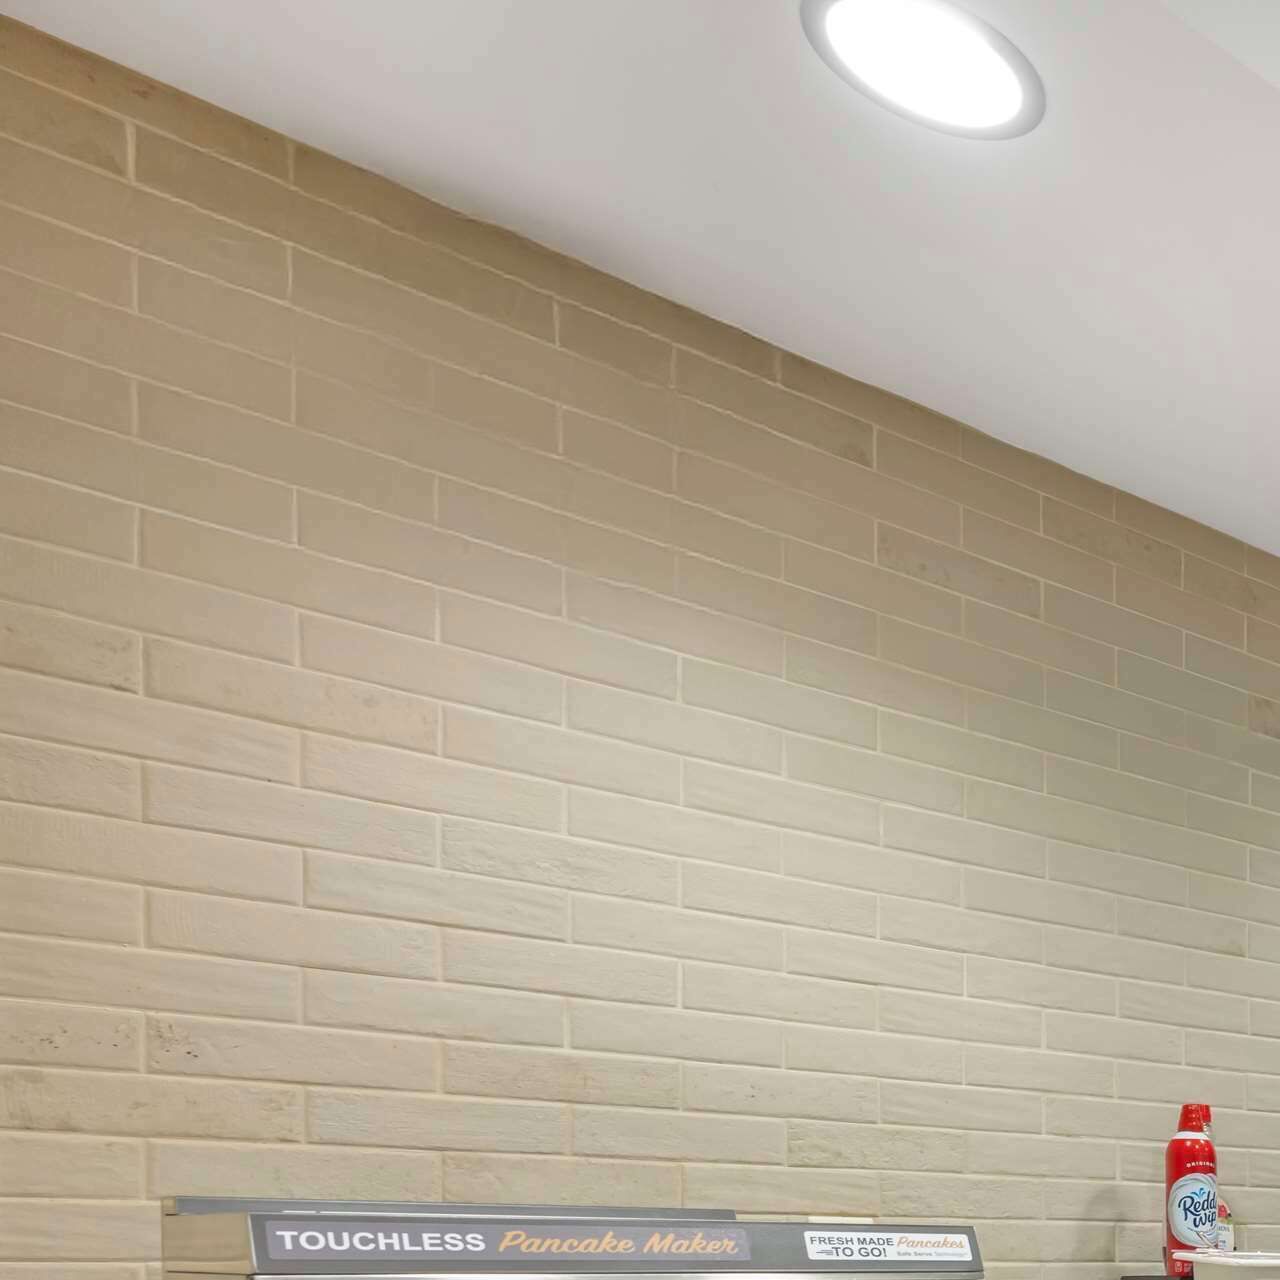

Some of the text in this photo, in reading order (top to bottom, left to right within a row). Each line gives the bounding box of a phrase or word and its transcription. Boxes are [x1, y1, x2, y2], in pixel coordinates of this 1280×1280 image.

[1178, 1190, 1217, 1222] Redd
[275, 1230, 739, 1255] TOUCHLESS Pancake Maker
[810, 1236, 895, 1246] FRESH MADE
[896, 1235, 965, 1249] Pancakes
[831, 1246, 888, 1258] TO GO!
